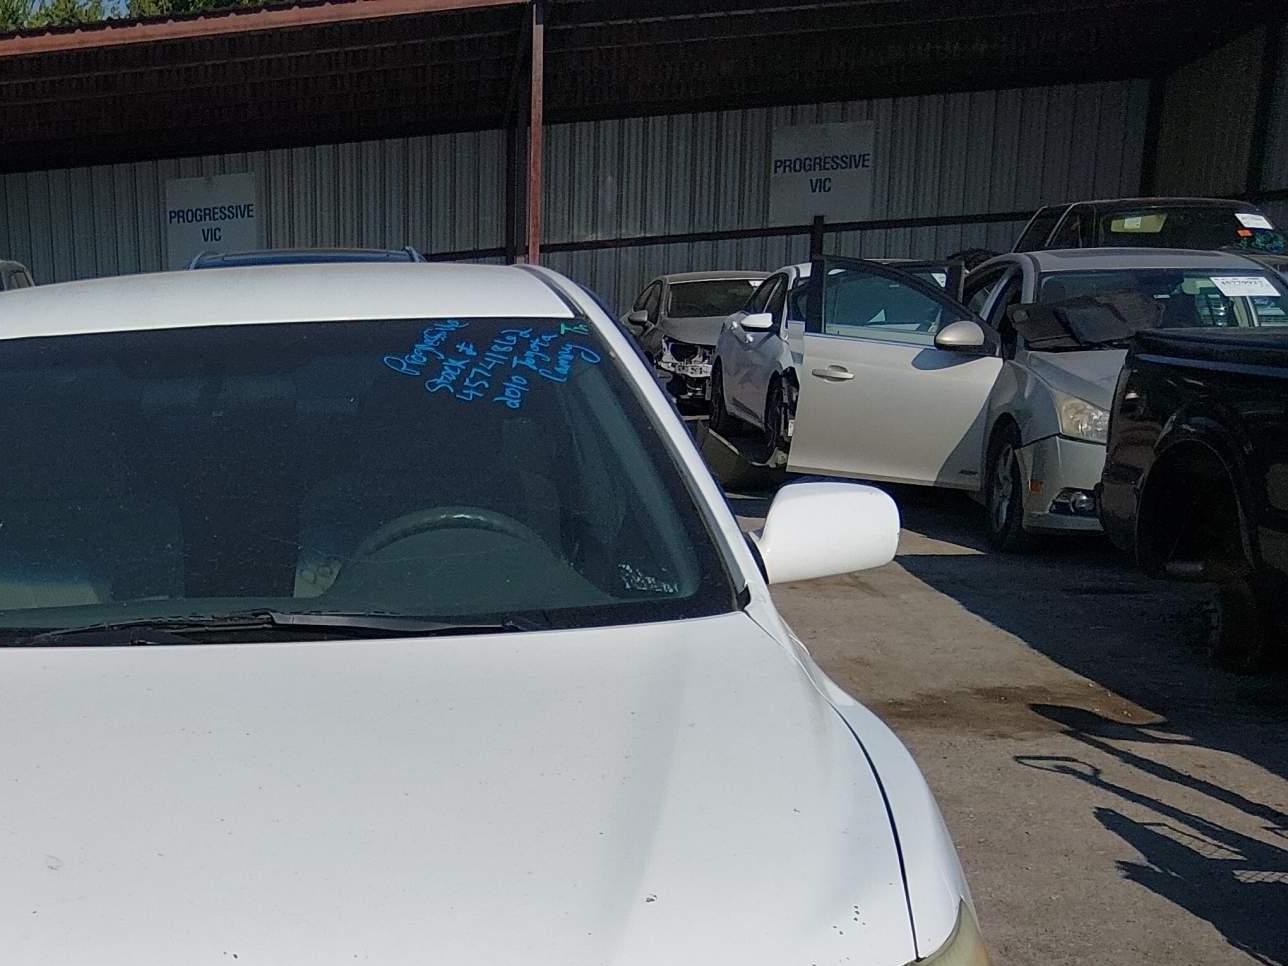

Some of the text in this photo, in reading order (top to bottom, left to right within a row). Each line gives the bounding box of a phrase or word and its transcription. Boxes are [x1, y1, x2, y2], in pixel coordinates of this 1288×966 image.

[773, 153, 871, 174] PROGRESSIVE
[809, 178, 832, 193] VIC
[168, 203, 255, 224] PROGRESSIVE
[201, 227, 222, 242] VIC
[455, 327, 533, 401] 45741862
[492, 334, 559, 409] 2010 Toyota
